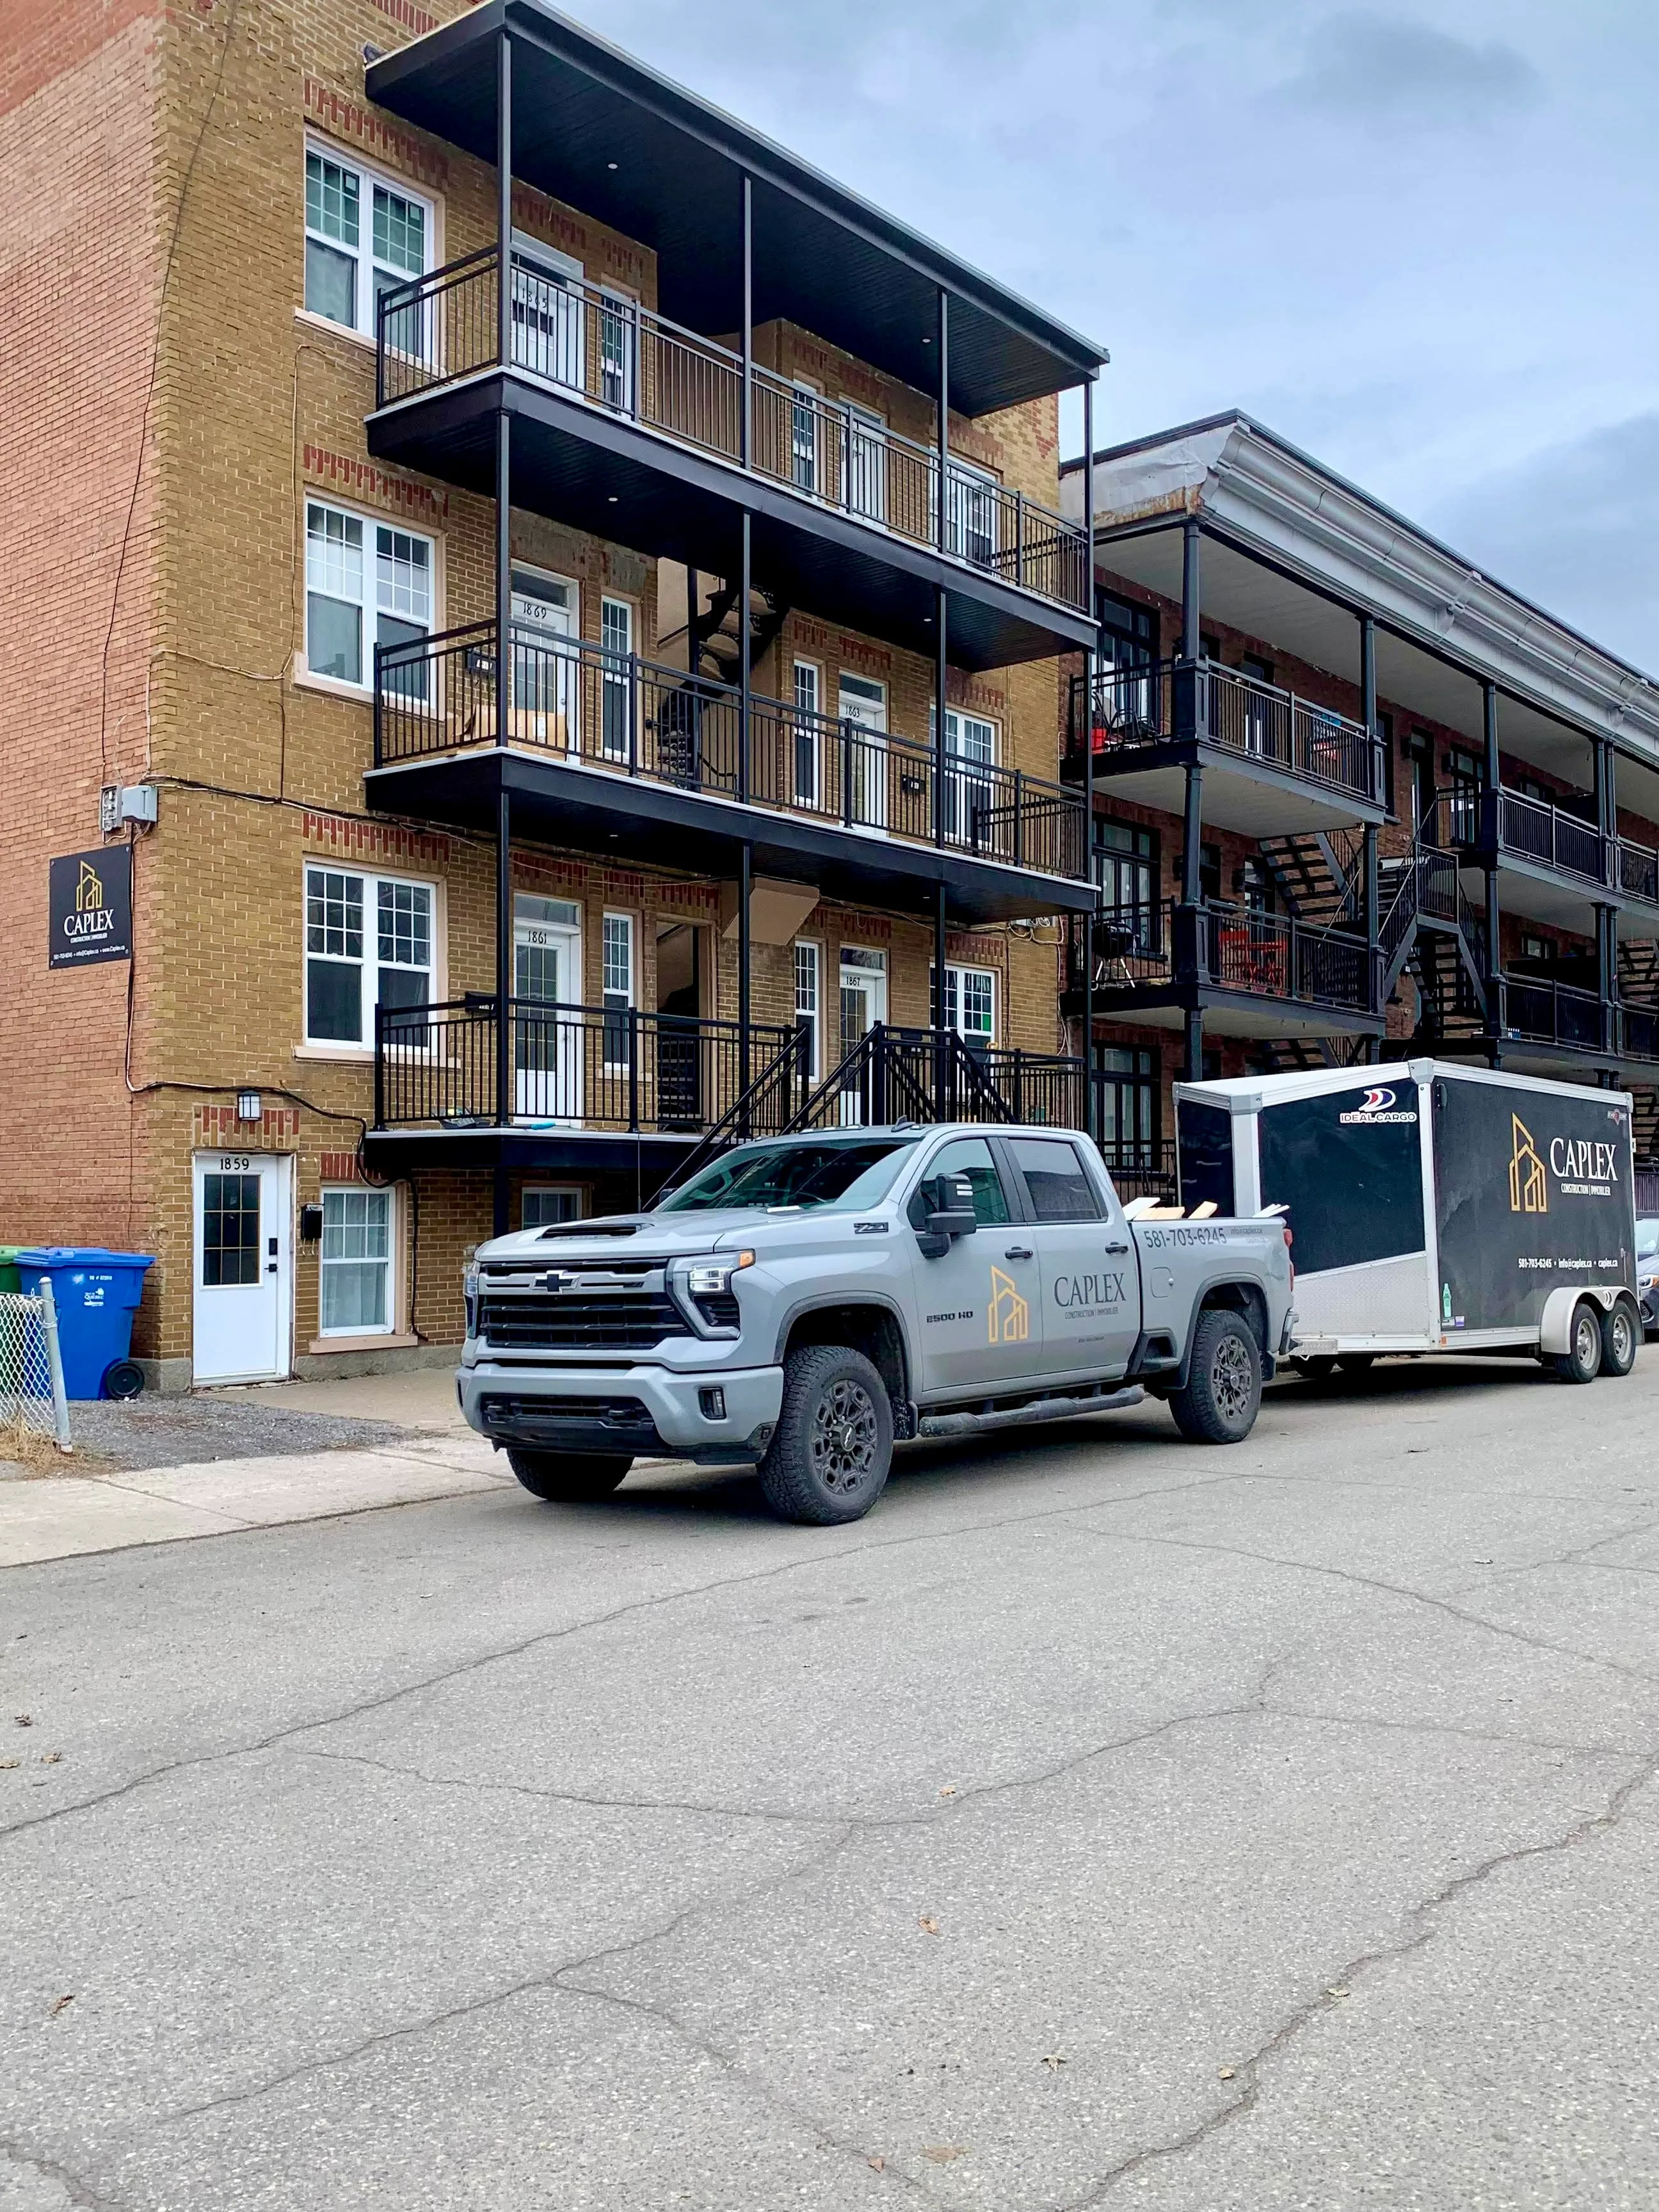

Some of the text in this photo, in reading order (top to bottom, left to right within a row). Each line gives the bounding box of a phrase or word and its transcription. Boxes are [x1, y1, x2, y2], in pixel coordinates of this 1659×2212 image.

[524, 602, 547, 618] 1869
[846, 706, 860, 718] 1863
[64, 909, 115, 936] CAPLEX
[528, 931, 547, 944] 1861
[846, 976, 860, 986] 1867
[1375, 1113, 1416, 1122] CARGO
[220, 1158, 250, 1170] 1859
[1550, 1138, 1618, 1181] CAPLEX
[1561, 1183, 1589, 1194] CONSTRUCTION
[853, 1222, 888, 1234] Z71
[1144, 1227, 1227, 1248] 581-703-6245
[1518, 1258, 1618, 1270] 581-703-6245 info@caplex.ca caplex.ca
[1054, 1273, 1126, 1307] CAPLEX
[926, 1311, 973, 1323] 2500 HD
[1064, 1309, 1094, 1319] CONSTRUCTION
